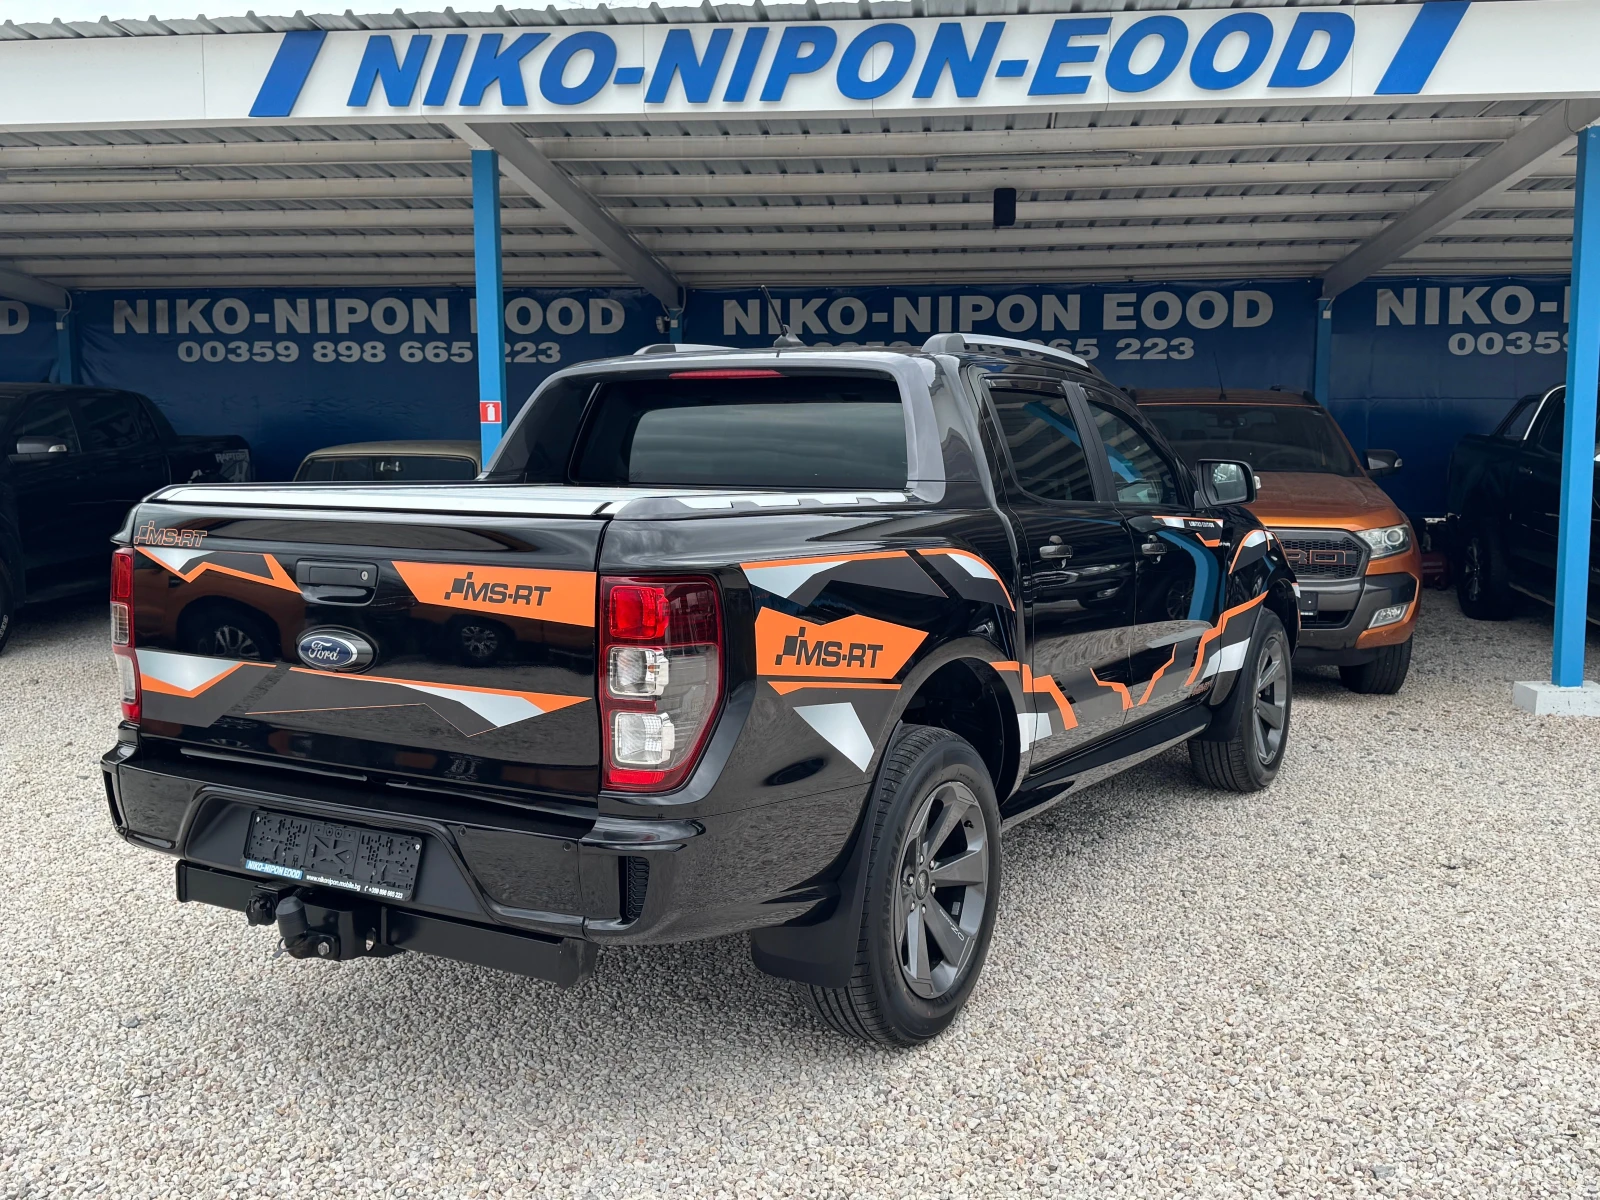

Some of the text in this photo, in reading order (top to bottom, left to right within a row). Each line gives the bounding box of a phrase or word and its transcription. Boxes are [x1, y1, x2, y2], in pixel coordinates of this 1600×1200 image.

[347, 12, 1355, 107] NIKO-NIPON-EOOD
[113, 296, 626, 336] NIKO-NIPON OOD
[723, 290, 1274, 336] NIKO-NIPON EOOD
[1376, 285, 1571, 326] NIKO-
[177, 340, 300, 364] 00359
[312, 340, 388, 363] 898
[399, 340, 474, 363] 665
[1115, 337, 1195, 360] 223
[1448, 331, 1569, 356] 0035
[308, 640, 341, 661] Ford
[247, 860, 284, 877] NIKO-NIPON
